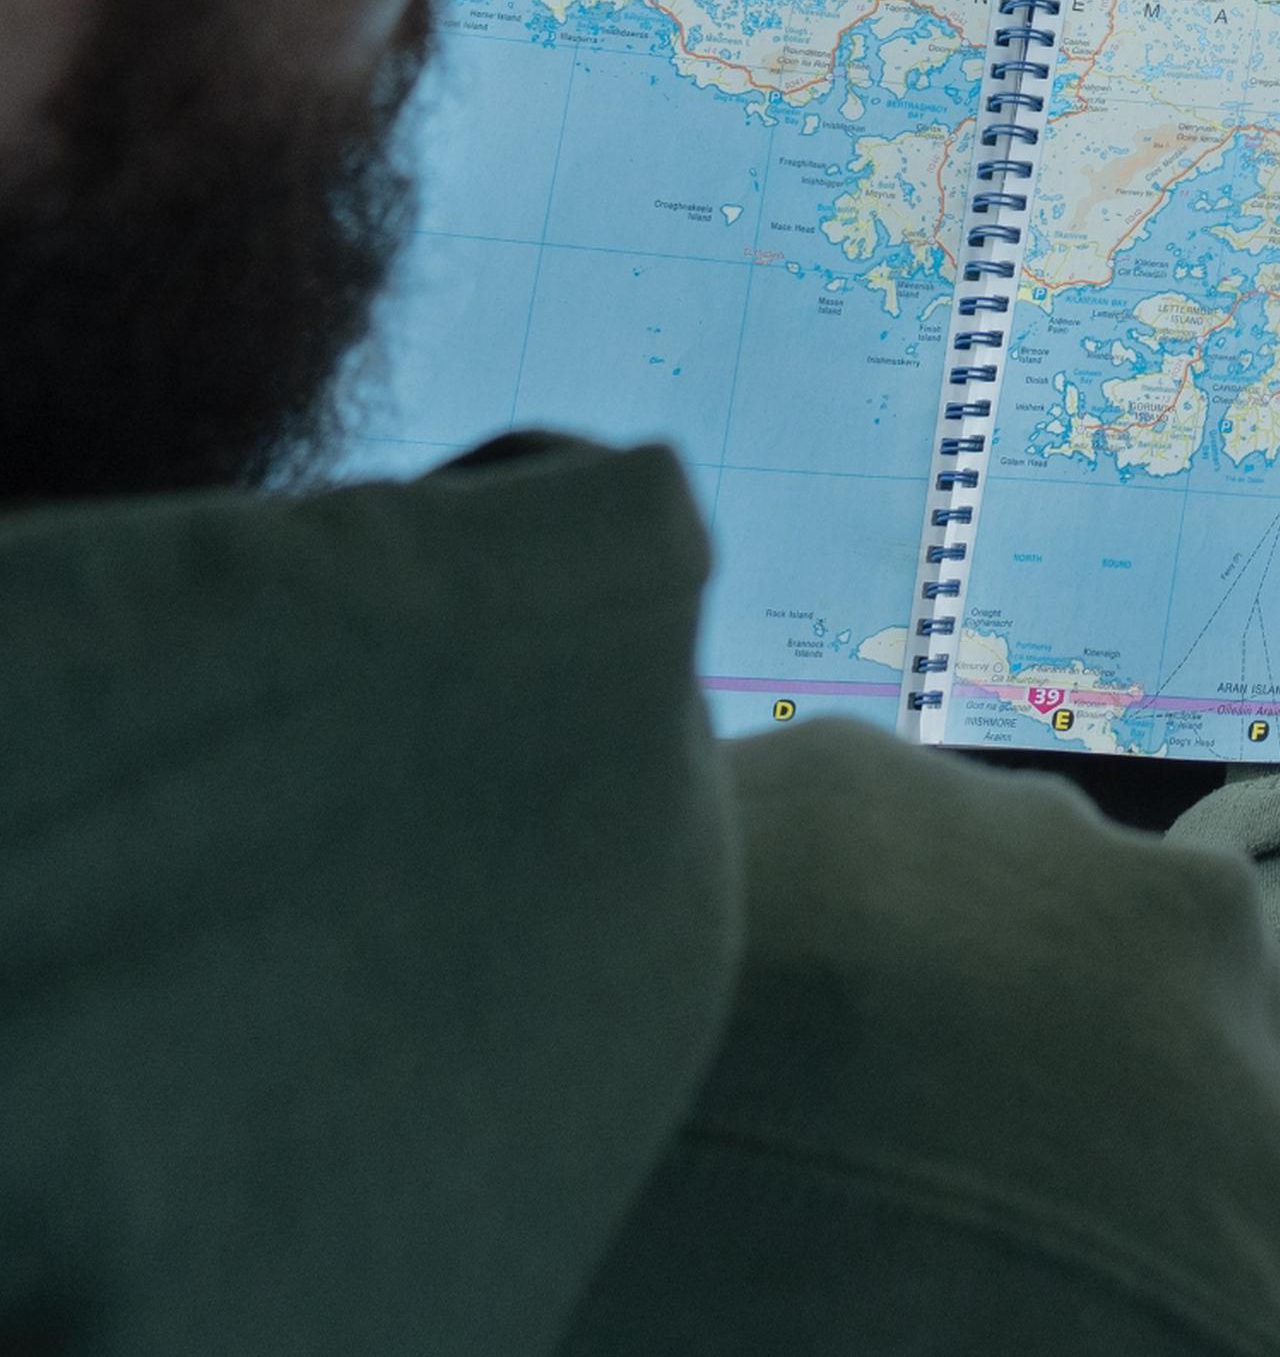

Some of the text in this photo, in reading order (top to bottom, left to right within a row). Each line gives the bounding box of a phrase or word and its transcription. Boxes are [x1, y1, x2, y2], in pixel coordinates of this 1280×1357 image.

[1034, 689, 1060, 705] 39
[1216, 682, 1248, 694] ARAN
[775, 702, 794, 720] D
[1055, 711, 1071, 729] E
[1250, 723, 1266, 741] F
